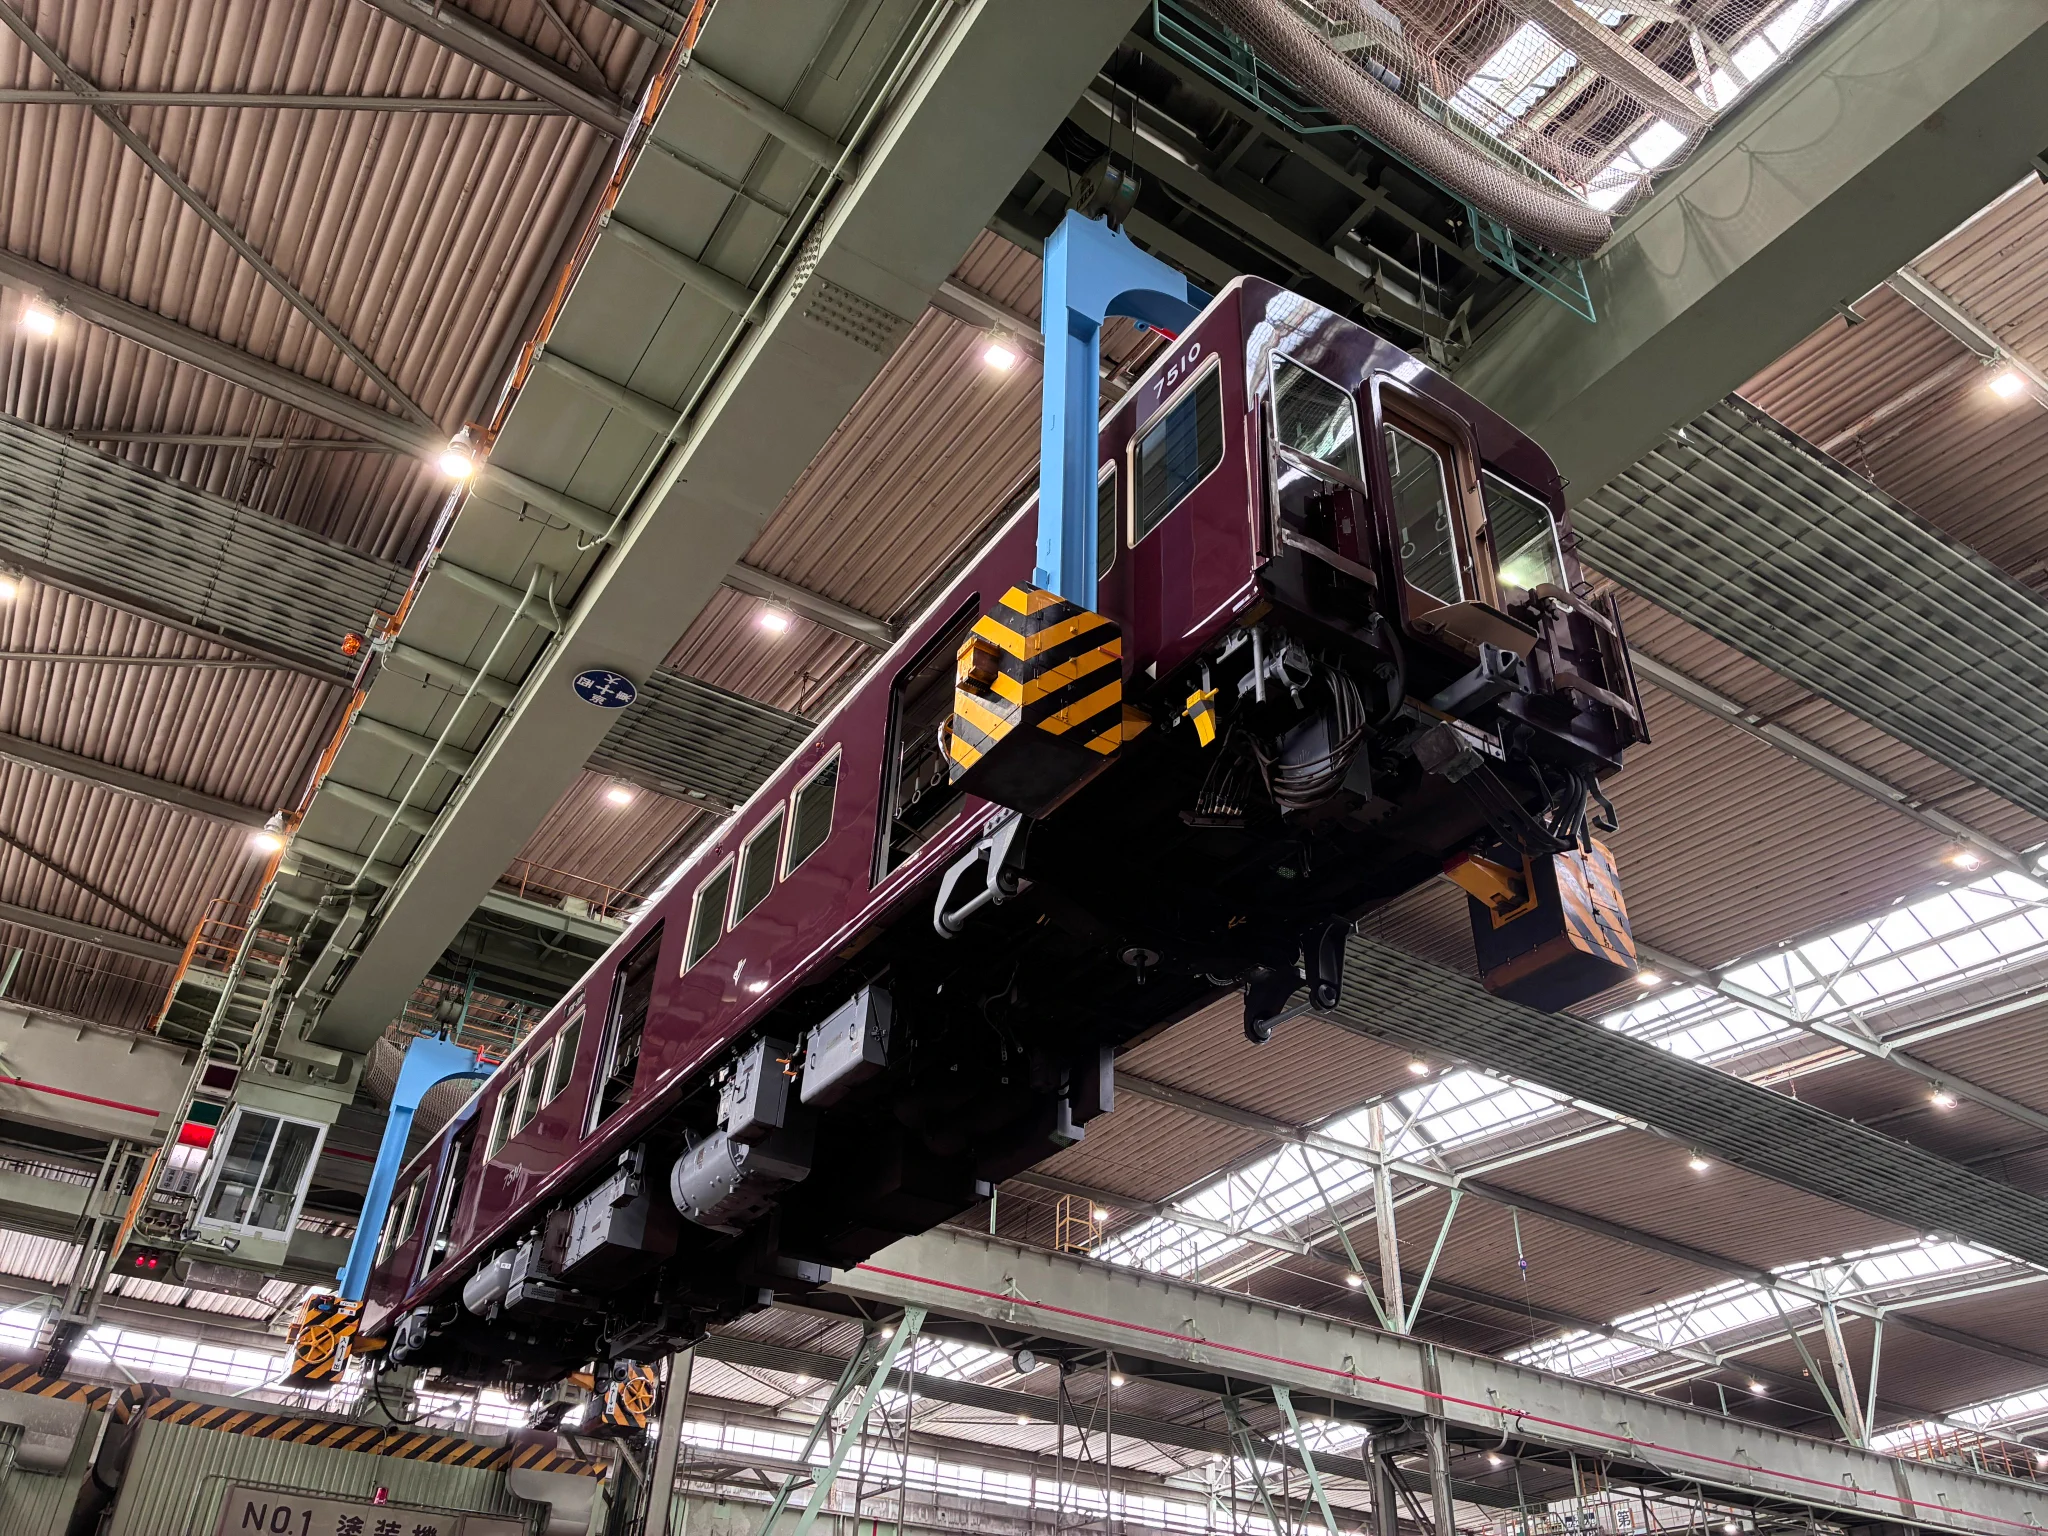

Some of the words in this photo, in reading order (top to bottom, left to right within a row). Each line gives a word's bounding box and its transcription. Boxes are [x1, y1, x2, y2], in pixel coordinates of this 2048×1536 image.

[1153, 342, 1201, 400] 7510
[241, 1501, 313, 1536] NO.1
[1617, 1510, 1631, 1528] 第
